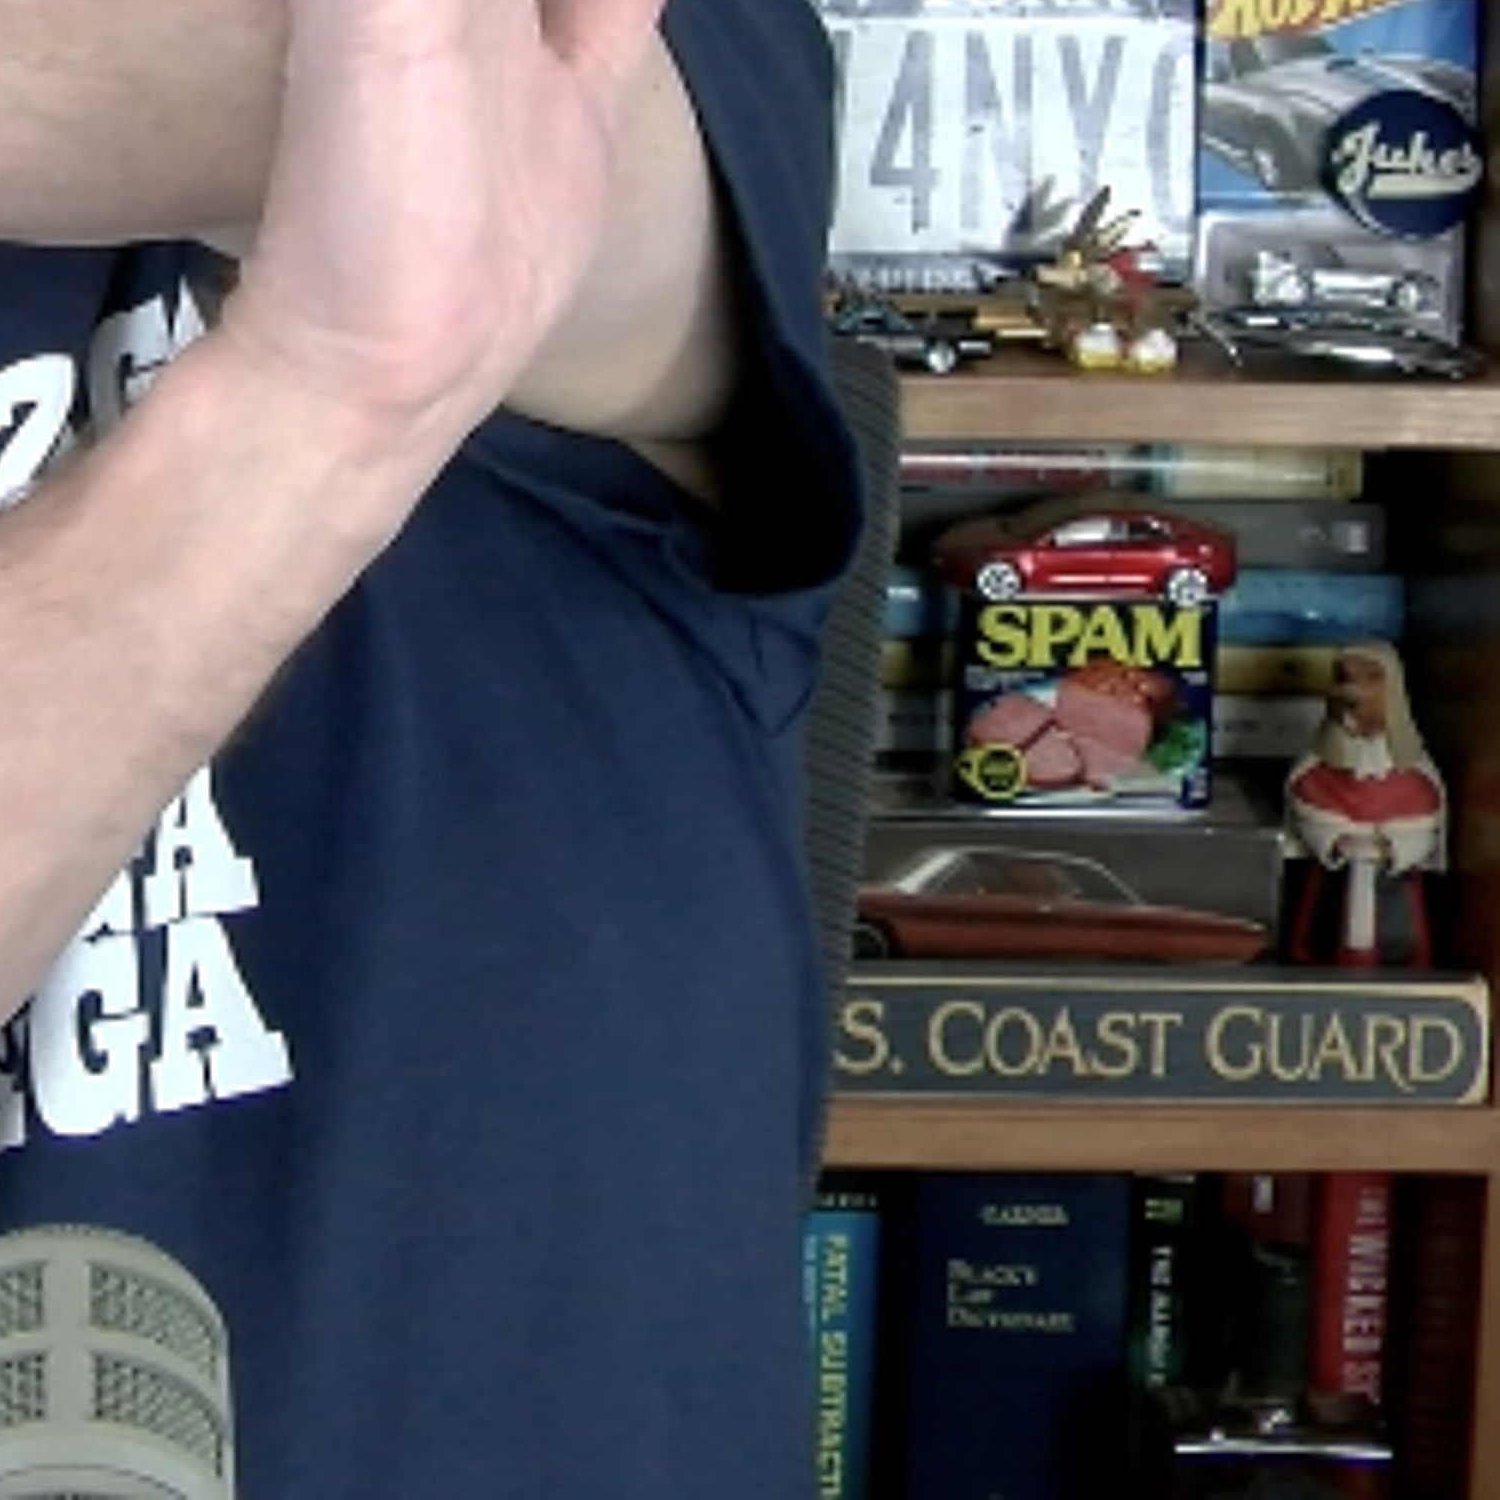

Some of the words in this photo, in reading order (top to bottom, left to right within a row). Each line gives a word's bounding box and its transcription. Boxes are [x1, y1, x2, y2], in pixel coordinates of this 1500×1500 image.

[975, 604, 1203, 668] SPAM
[928, 1001, 1182, 1078] COAST
[1205, 1007, 1463, 1091] GUARD
[820, 1233, 849, 1322] FATAL
[1343, 1230, 1390, 1353] WICKED
[815, 1330, 849, 1500] SUBTRACTI
